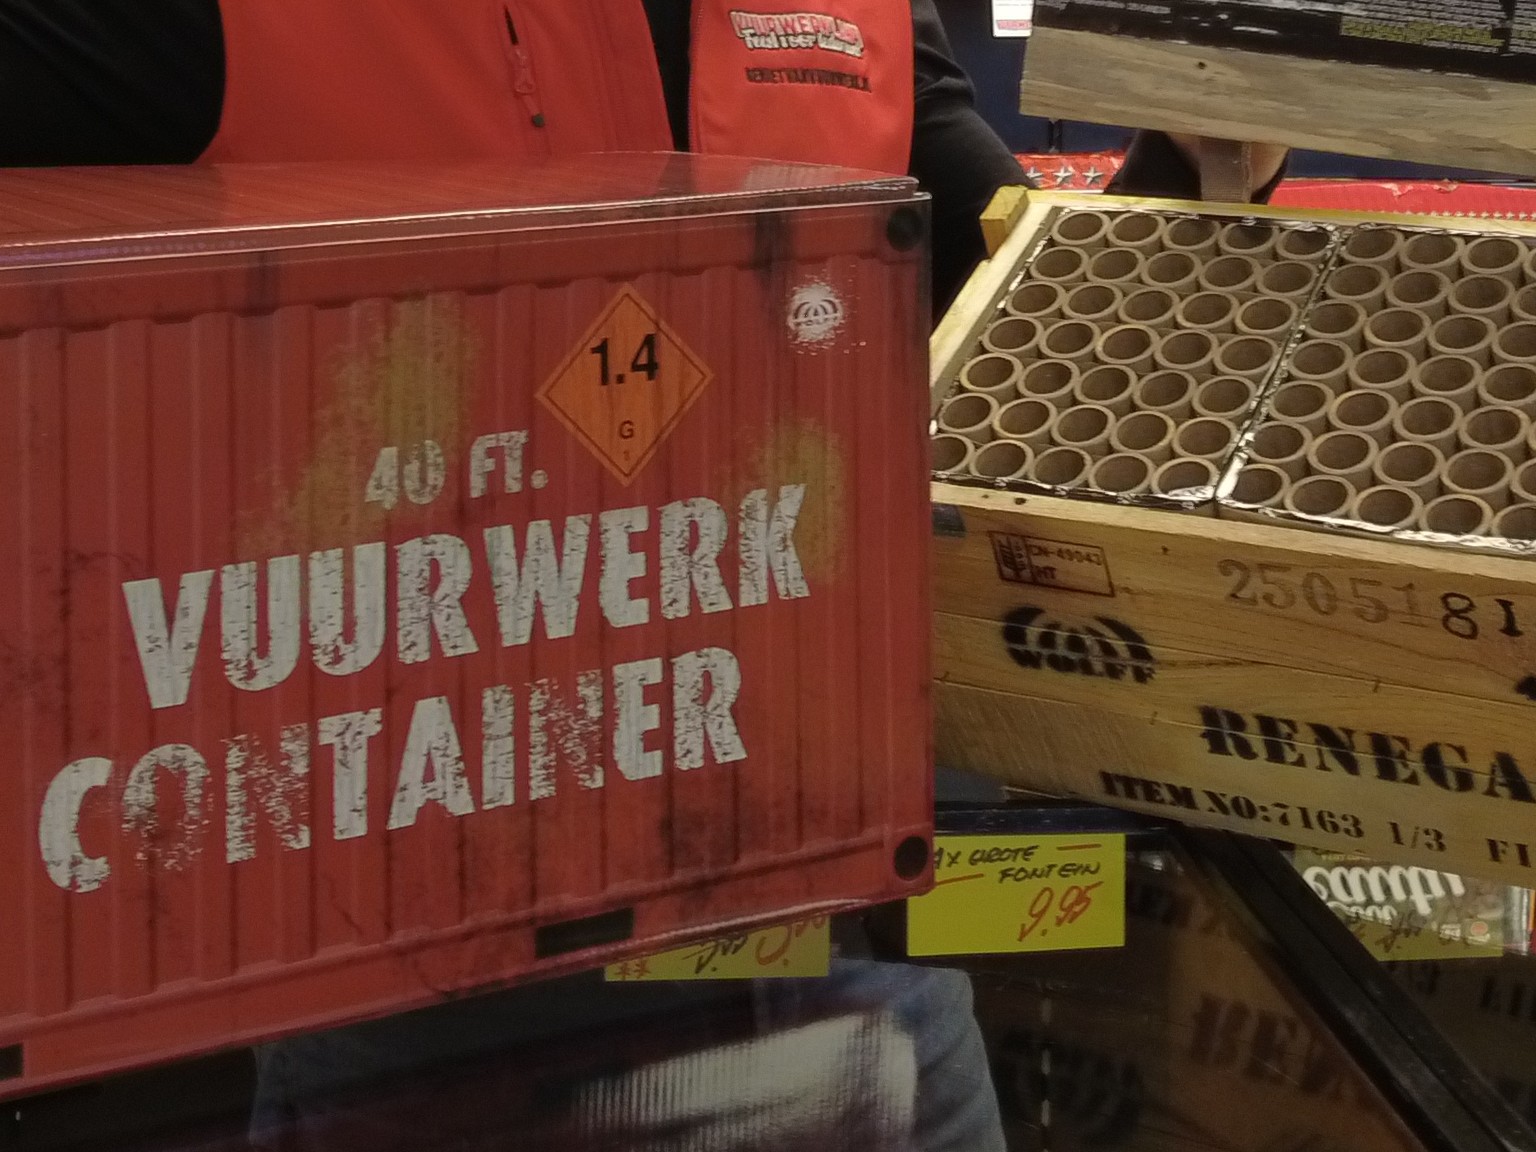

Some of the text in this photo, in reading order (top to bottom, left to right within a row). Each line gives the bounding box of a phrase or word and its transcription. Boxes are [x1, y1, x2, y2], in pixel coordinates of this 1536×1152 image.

[590, 333, 659, 386] 1.4
[365, 429, 549, 510] 40 FT.
[618, 420, 635, 440] G
[122, 483, 810, 709] VUURWERK
[1010, 646, 1156, 684] WOLFF
[37, 647, 748, 895] CONTAINER
[1100, 770, 1197, 810] ITEM
[1389, 821, 1447, 853] 1/3
